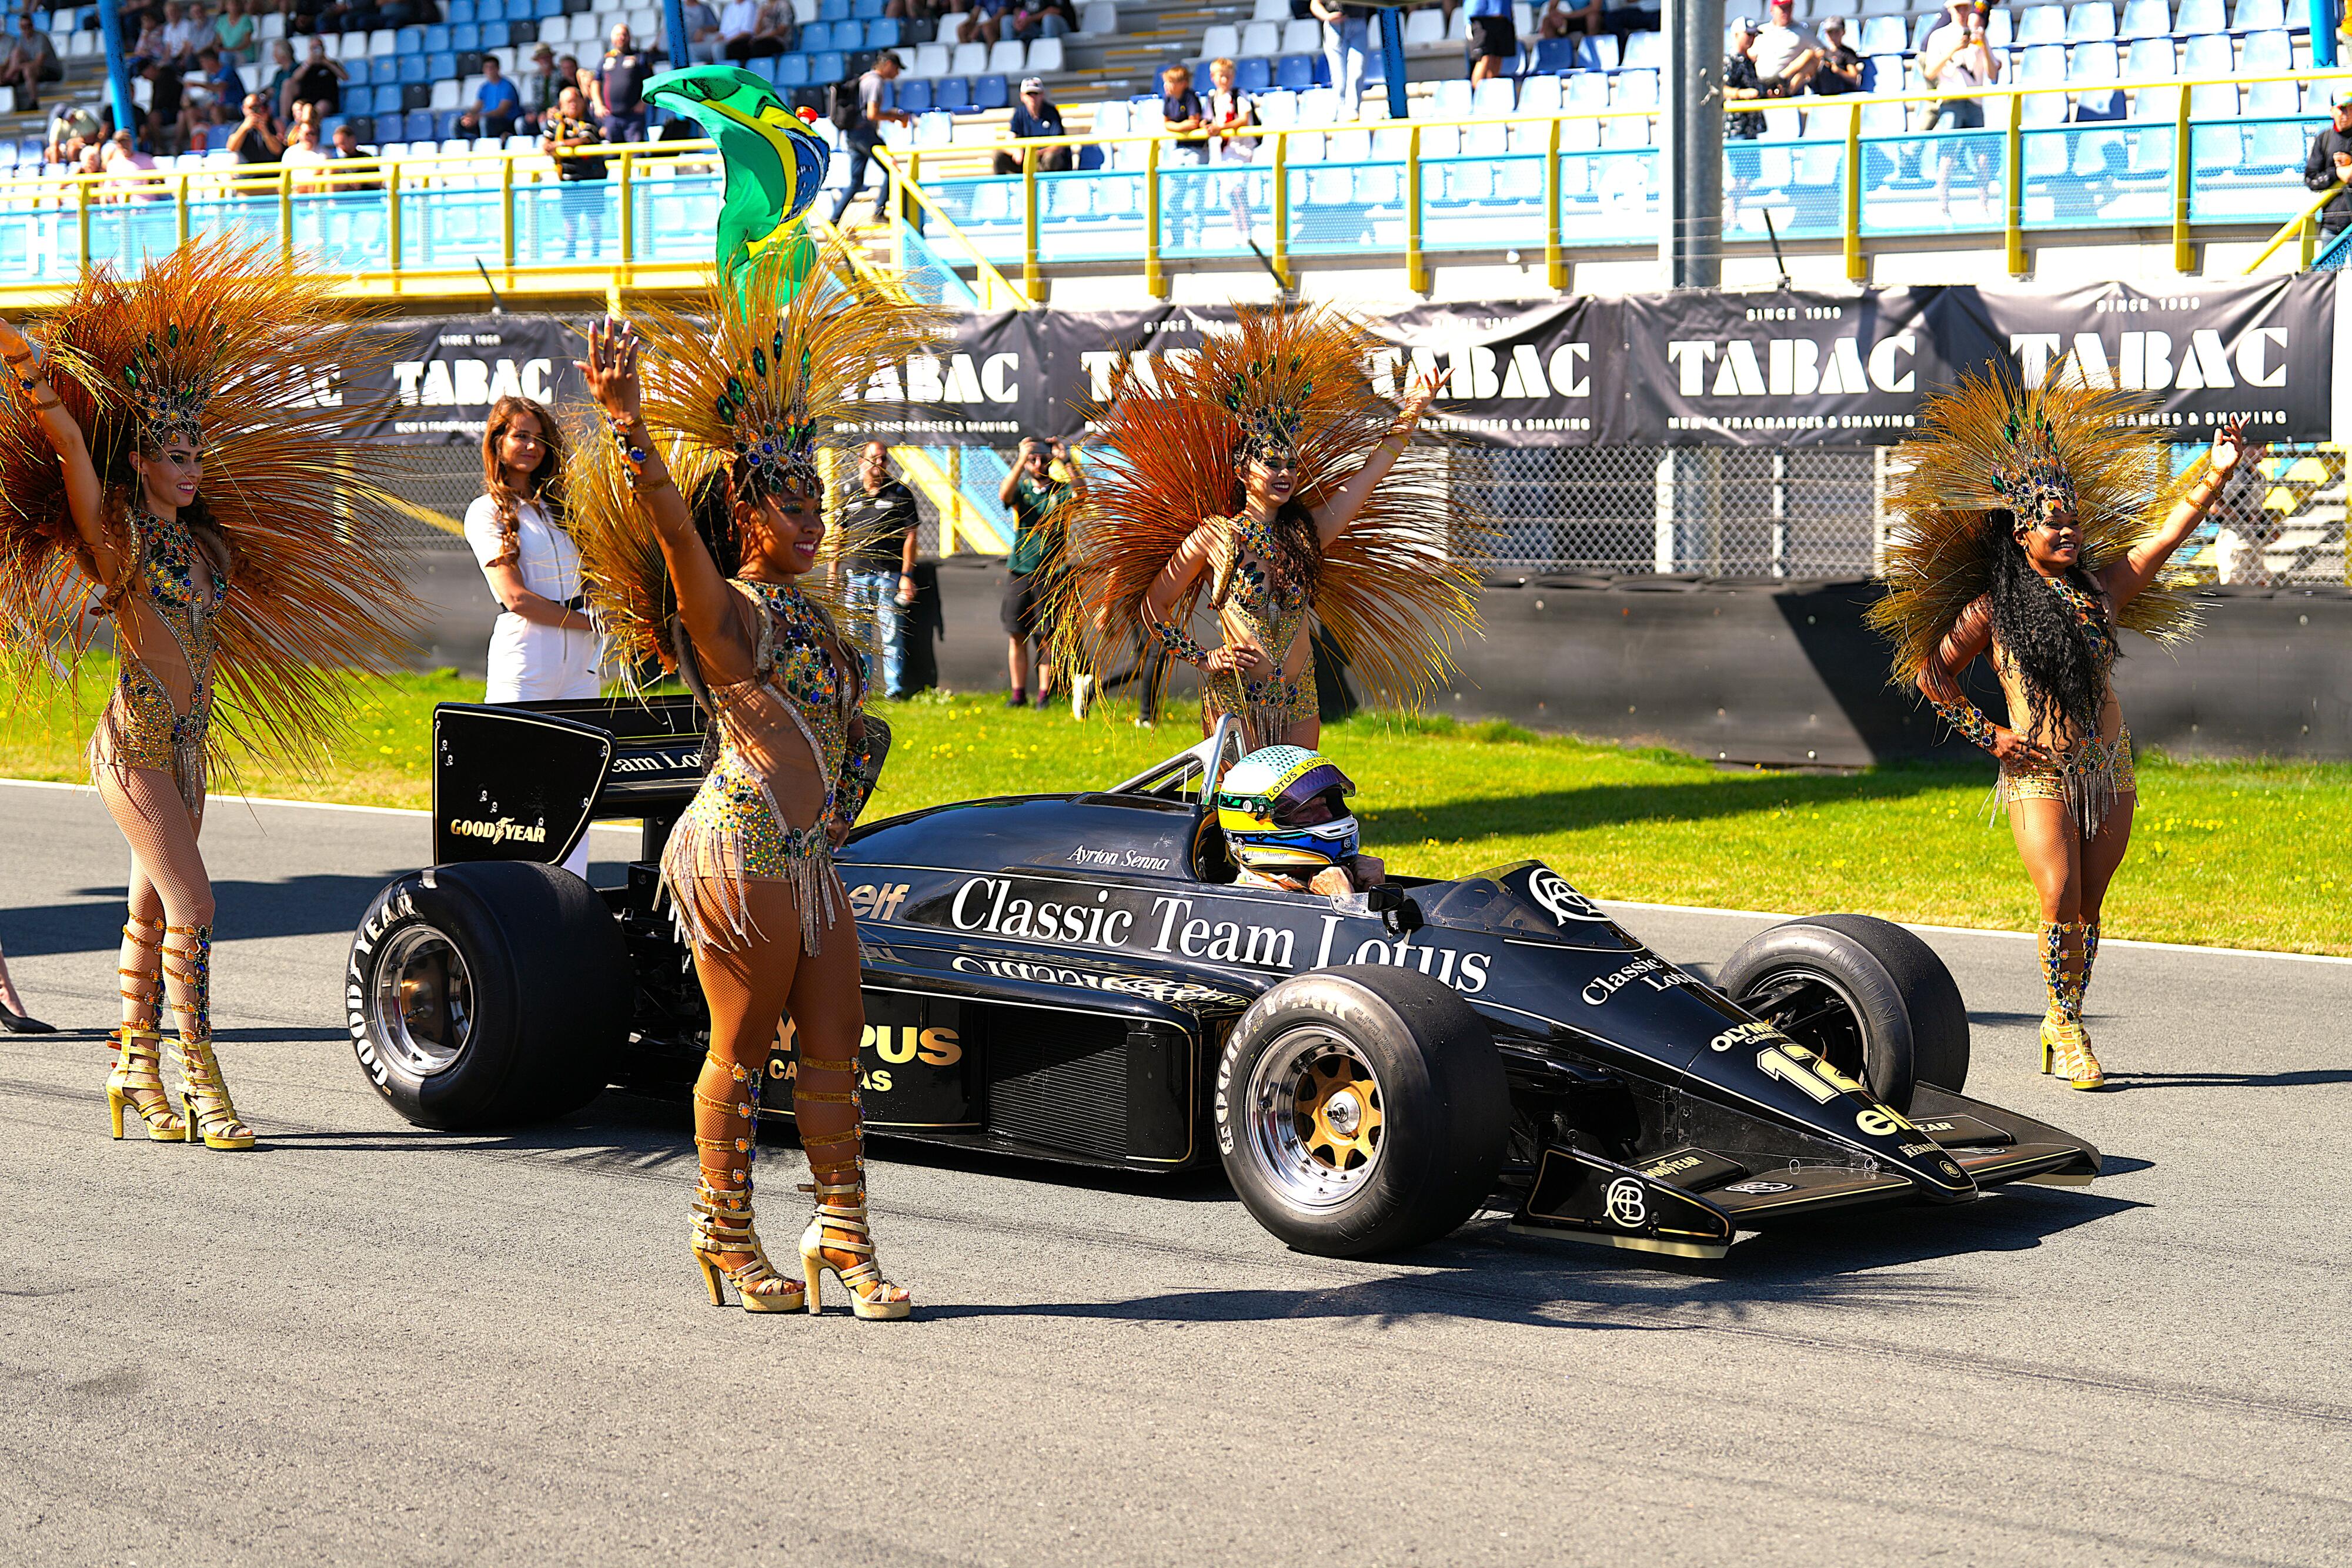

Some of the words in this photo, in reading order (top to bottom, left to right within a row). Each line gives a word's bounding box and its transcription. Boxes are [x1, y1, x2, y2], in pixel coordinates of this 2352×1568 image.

[1746, 307, 1797, 322] SINCE
[1805, 306, 1842, 320] 1959
[2096, 298, 2150, 313] SINCE
[2160, 296, 2200, 311] 1959
[1362, 343, 1590, 399] TABAC
[1668, 336, 1916, 396] TABAC
[2010, 327, 2288, 391] TABAC
[393, 358, 552, 406] TABAC
[1526, 417, 1591, 431] SHAVING
[1723, 416, 1824, 430] FRAGRANCES
[1827, 416, 1838, 429] &
[1842, 414, 1916, 429] SHAVING
[2188, 412, 2200, 426] &
[1268, 771, 1297, 798] LOTUS
[1301, 757, 1329, 770] LOTUS
[450, 817, 546, 844] GOODYEAR
[1067, 844, 1120, 866] Ayrton
[1120, 850, 1170, 871] Senna
[848, 882, 911, 921] elf
[951, 877, 1133, 948] Classic
[1150, 895, 1295, 969] Team
[1309, 914, 1492, 994] Lotus
[1582, 956, 1664, 1006] Classic
[1823, 944, 1897, 1027] AVON
[1710, 1022, 1775, 1052] OLYMP
[1756, 1042, 1867, 1105] 12
